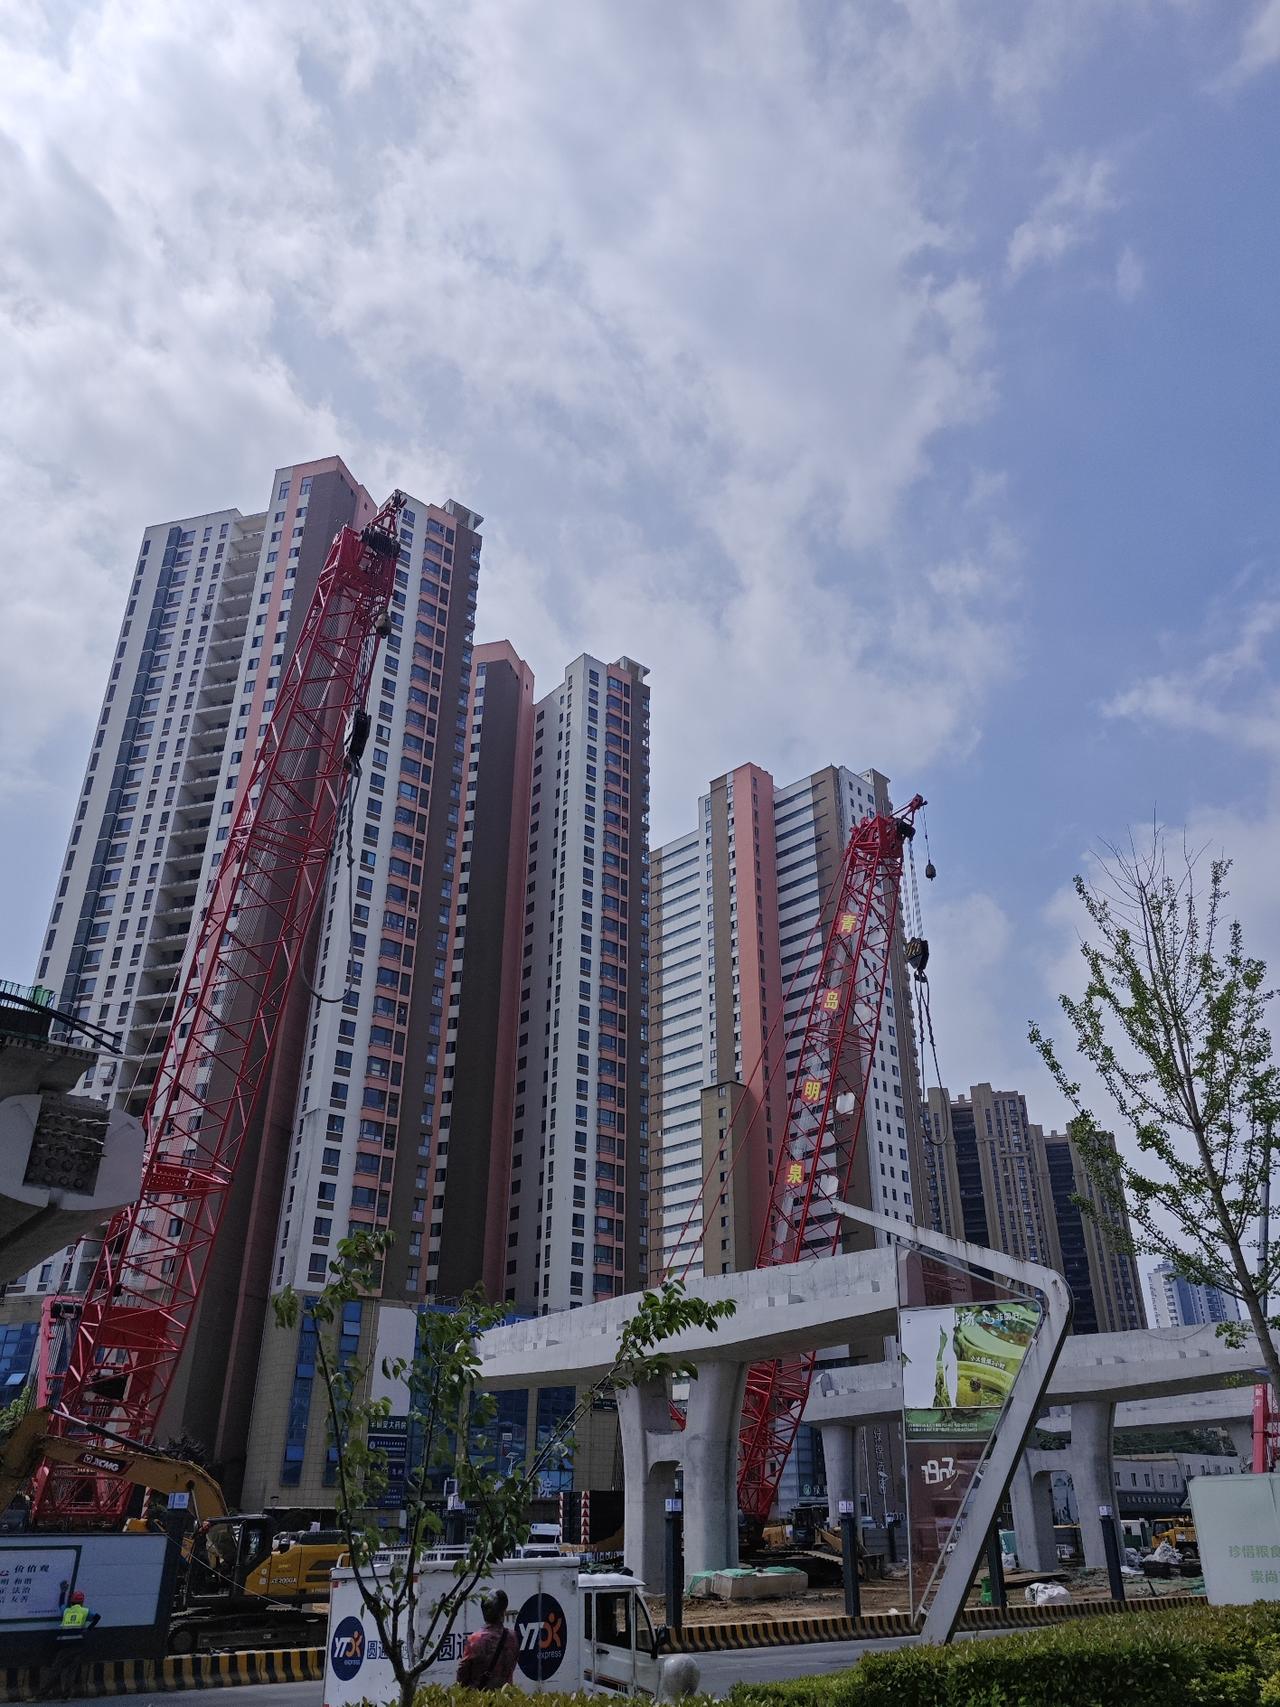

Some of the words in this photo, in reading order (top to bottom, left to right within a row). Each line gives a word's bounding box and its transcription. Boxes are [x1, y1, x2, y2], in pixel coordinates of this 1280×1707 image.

[93, 1457, 119, 1472] XCMG
[1228, 1544, 1280, 1559] 珍惜粮食
[536, 1649, 562, 1660] express
